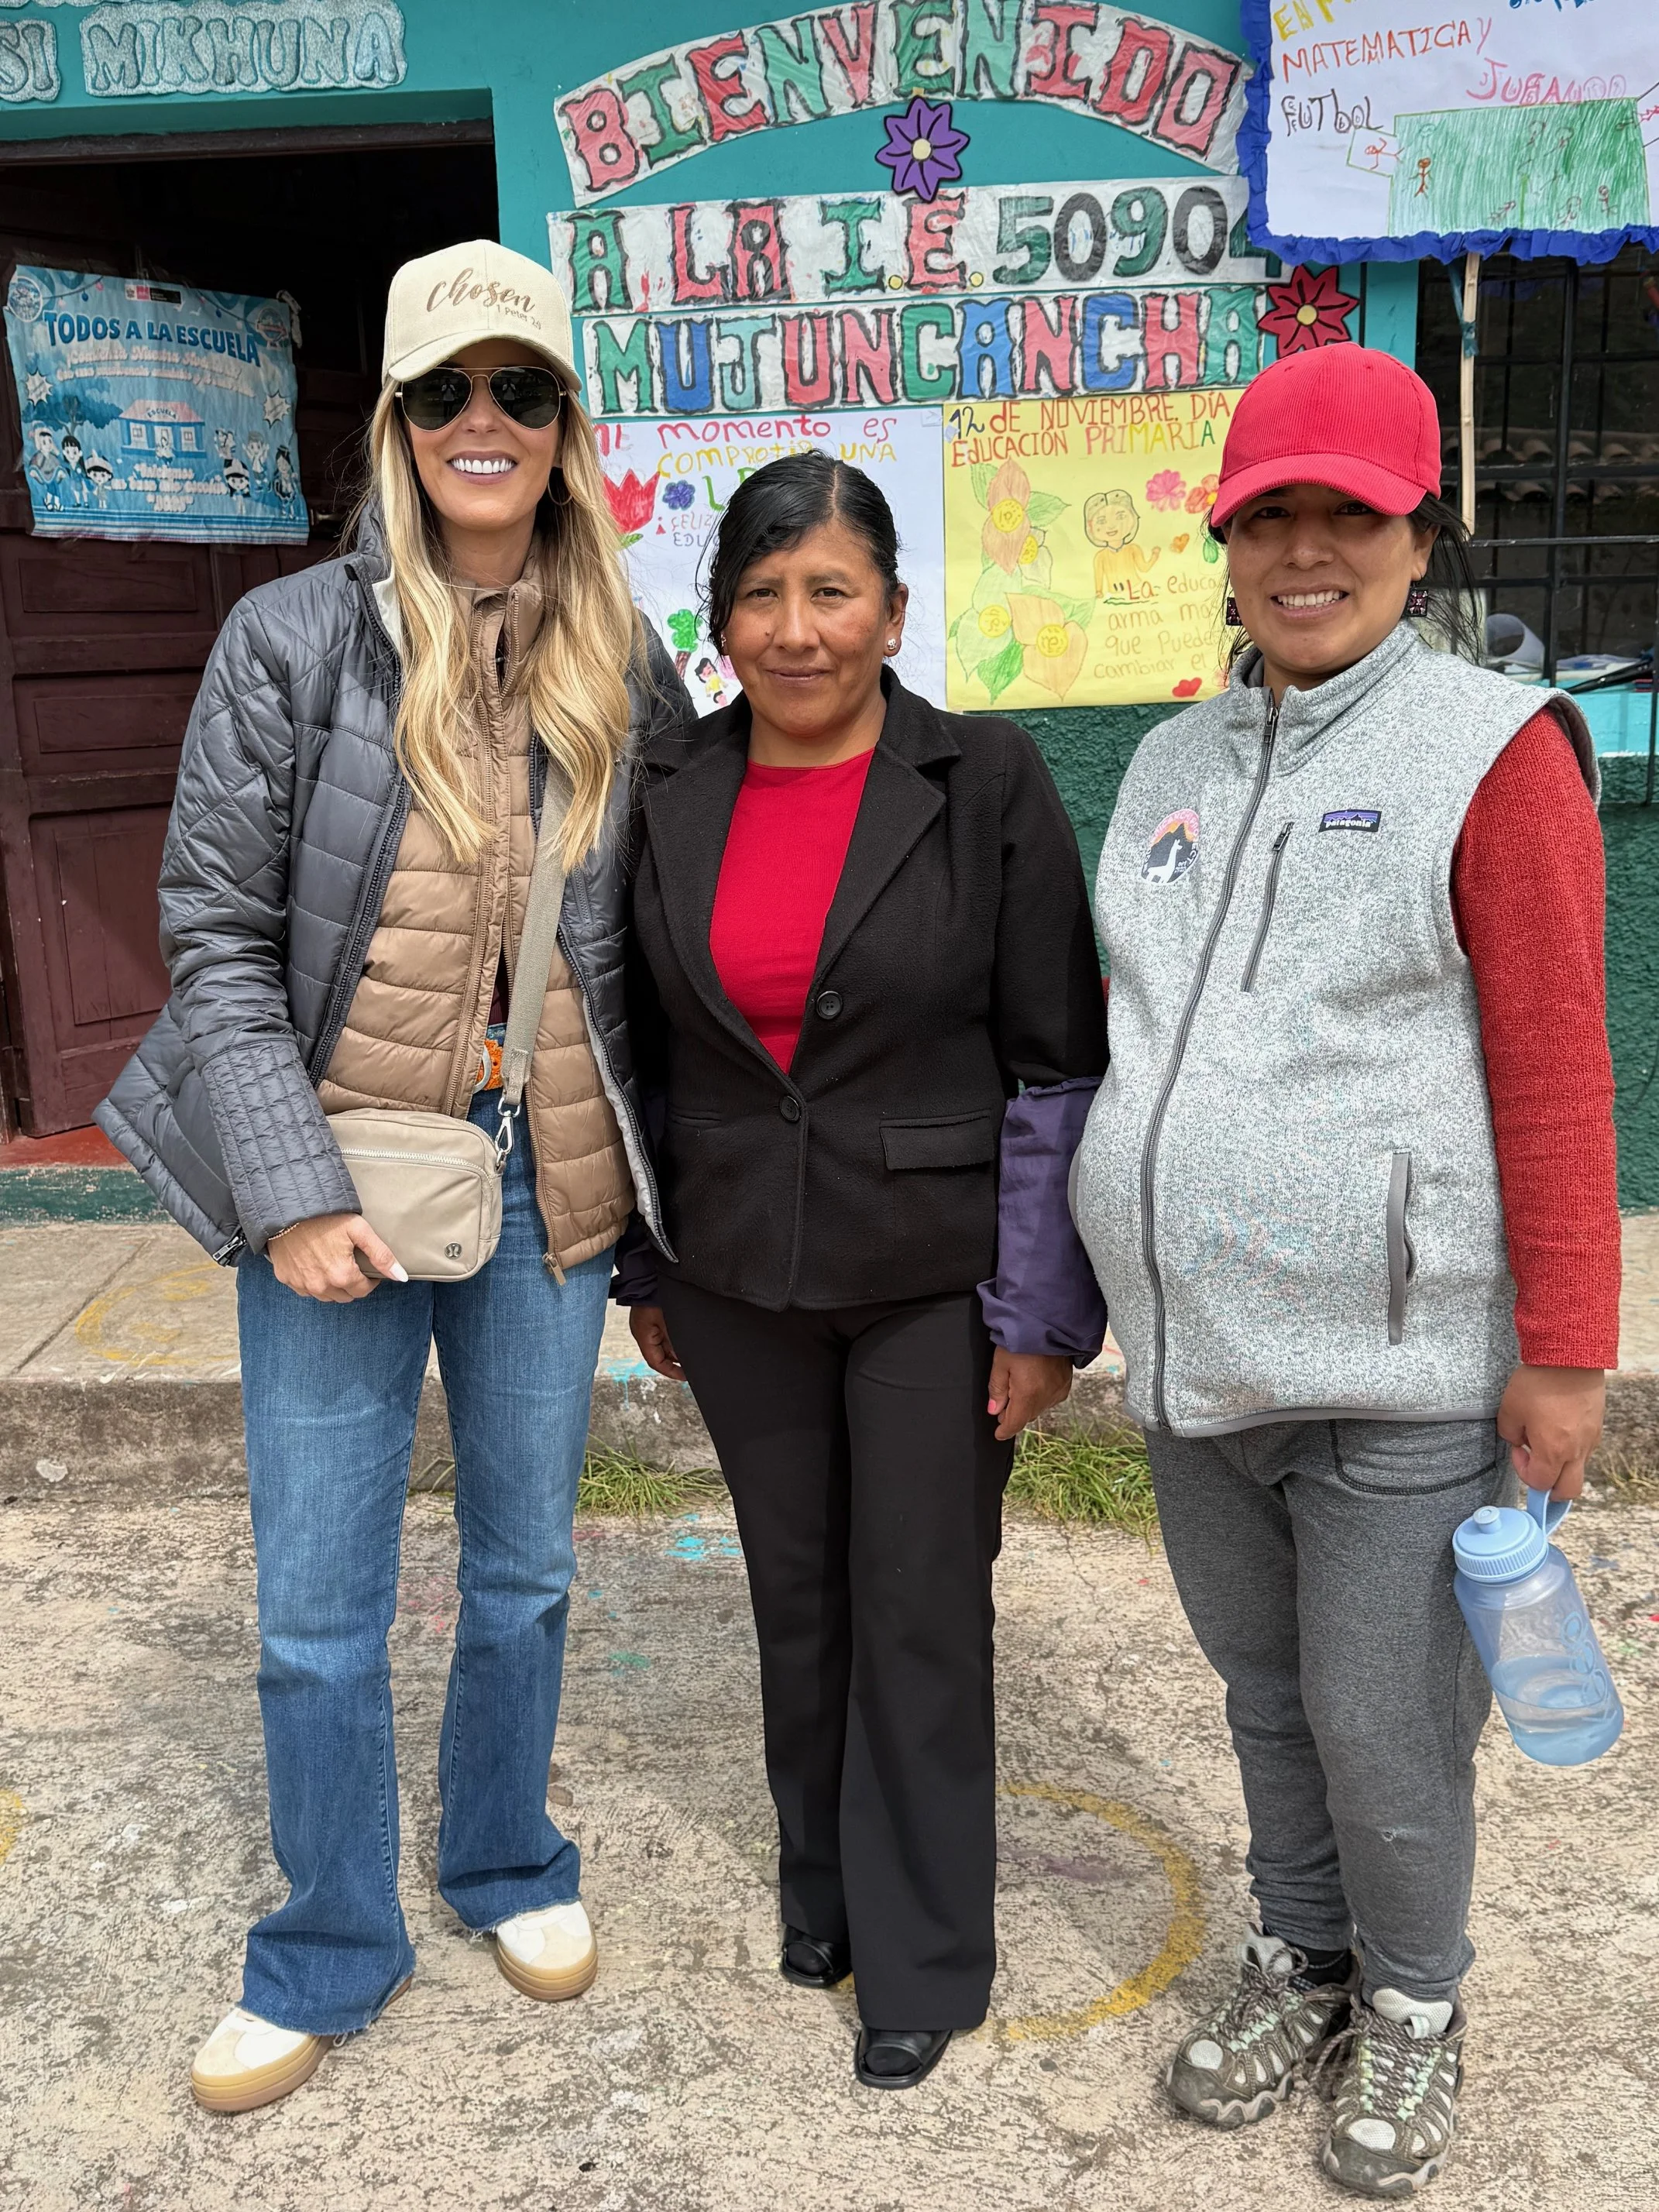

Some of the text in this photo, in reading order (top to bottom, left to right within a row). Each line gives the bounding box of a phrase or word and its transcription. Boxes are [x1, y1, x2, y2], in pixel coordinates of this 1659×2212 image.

[88, 12, 399, 88] MIKHUNA
[558, 0, 1241, 192] BIENVENIDO
[565, 210, 634, 310] A
[668, 199, 795, 305] LA
[43, 311, 121, 347] TODOS
[125, 320, 143, 341] A
[146, 321, 173, 343] LA
[176, 324, 262, 369] ESCUELA
[593, 286, 1262, 414] MUJUNCANCHA
[949, 406, 985, 441] 12
[1190, 391, 1231, 421] DÍA
[1084, 418, 1216, 456] PRIMARIA
[1108, 610, 1163, 631] arma
[1094, 659, 1175, 679] cambiar
[1104, 635, 1141, 657] que
[1325, 819, 1372, 829] patagonia
